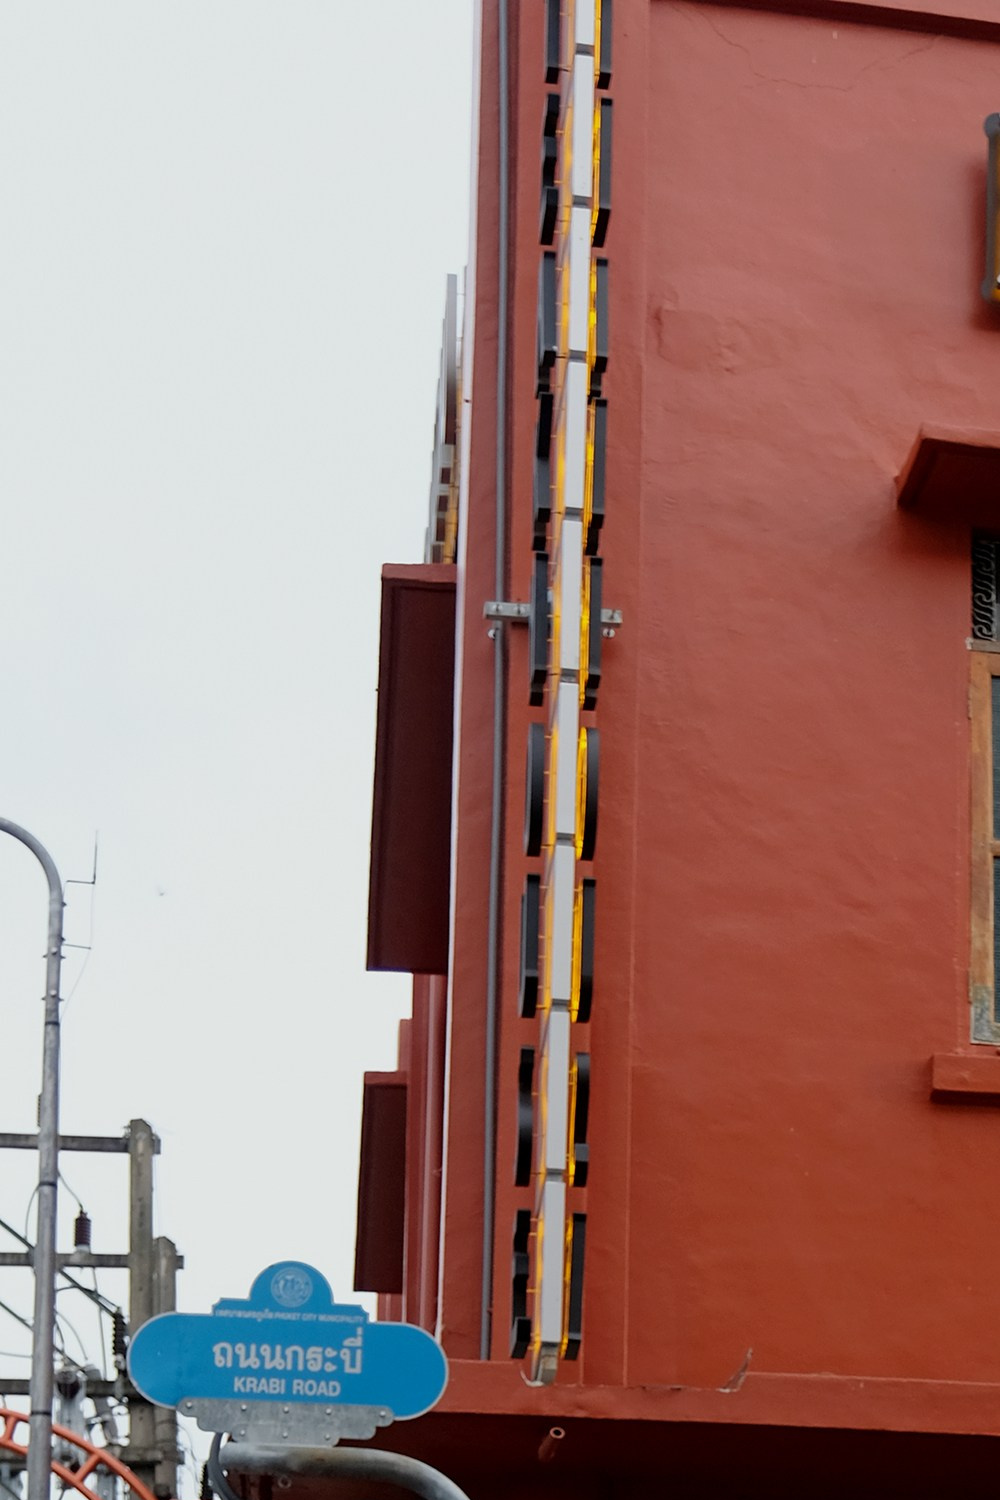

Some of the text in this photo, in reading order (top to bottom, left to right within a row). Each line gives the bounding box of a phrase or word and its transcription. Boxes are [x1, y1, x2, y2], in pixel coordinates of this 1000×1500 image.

[212, 1327, 364, 1375] ถนนกระบี่
[233, 1376, 341, 1397] KRABI ROAD
